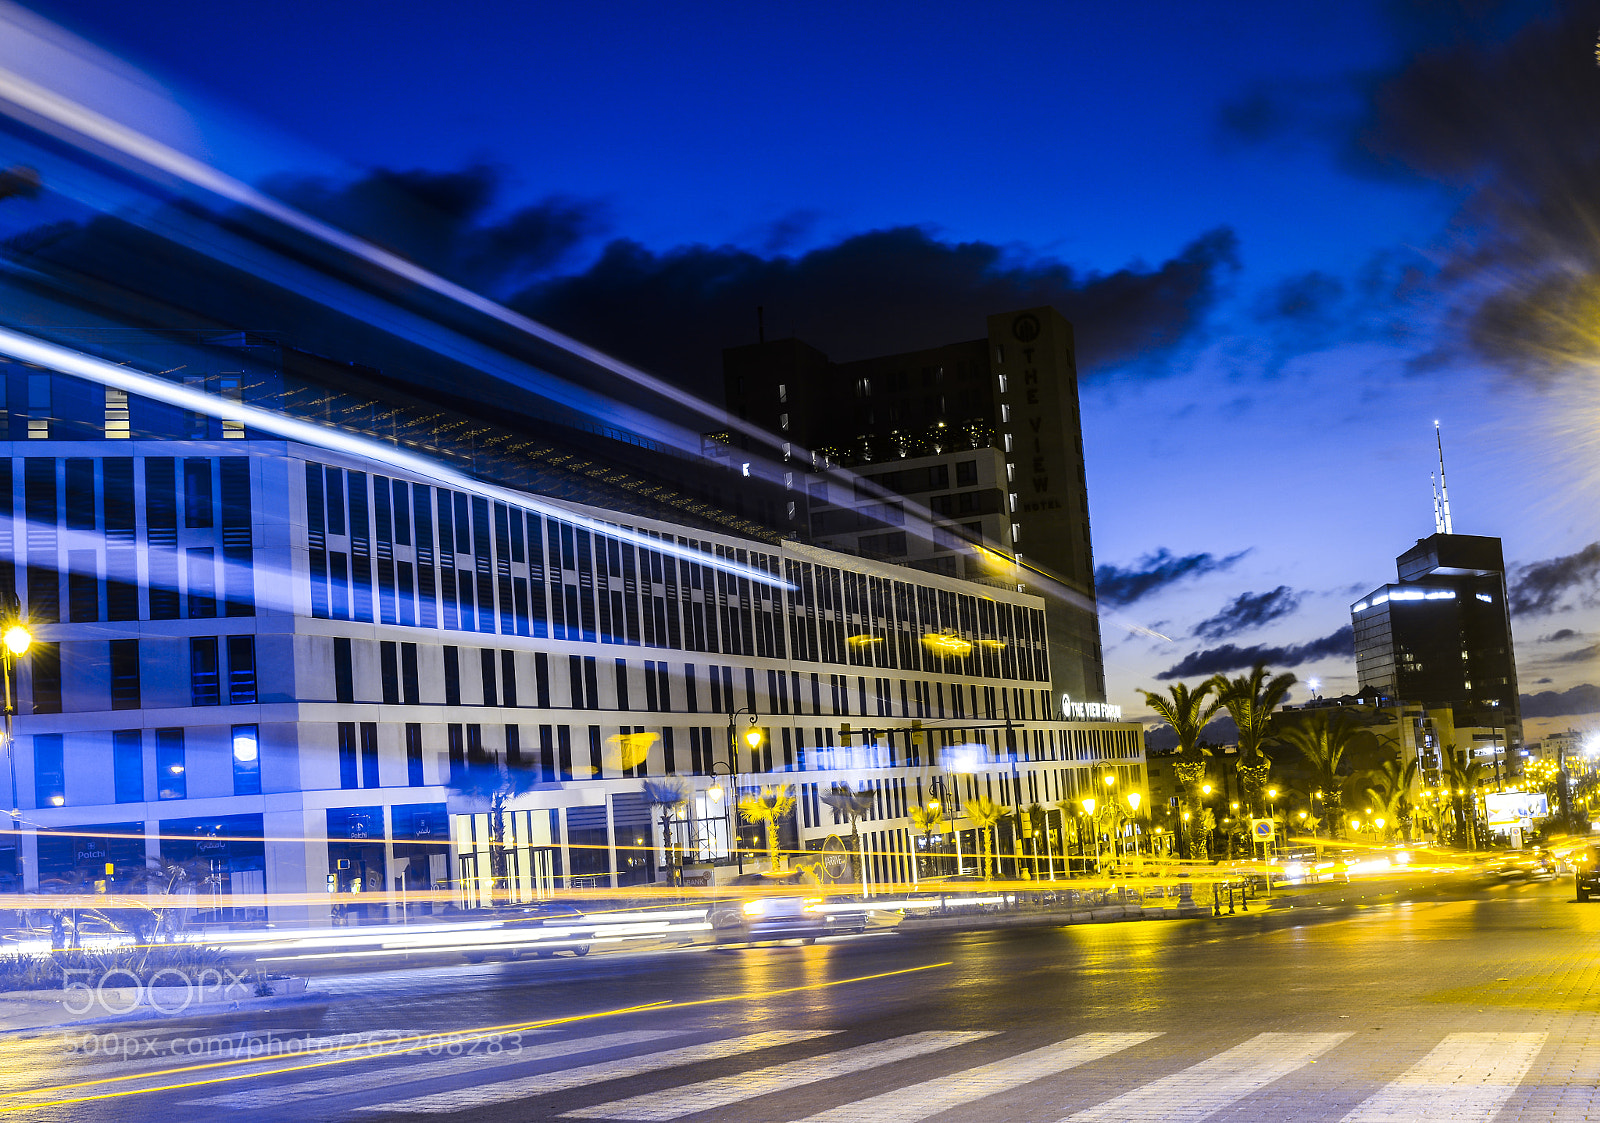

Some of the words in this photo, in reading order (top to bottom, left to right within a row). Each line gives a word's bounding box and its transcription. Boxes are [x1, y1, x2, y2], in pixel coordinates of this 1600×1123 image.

[1023, 348, 1039, 405] THE
[1029, 417, 1048, 493] VIEW
[1024, 500, 1062, 512] HOTEL
[1071, 702, 1085, 717] THE
[78, 850, 106, 859] Patchi
[686, 878, 704, 886] BANK
